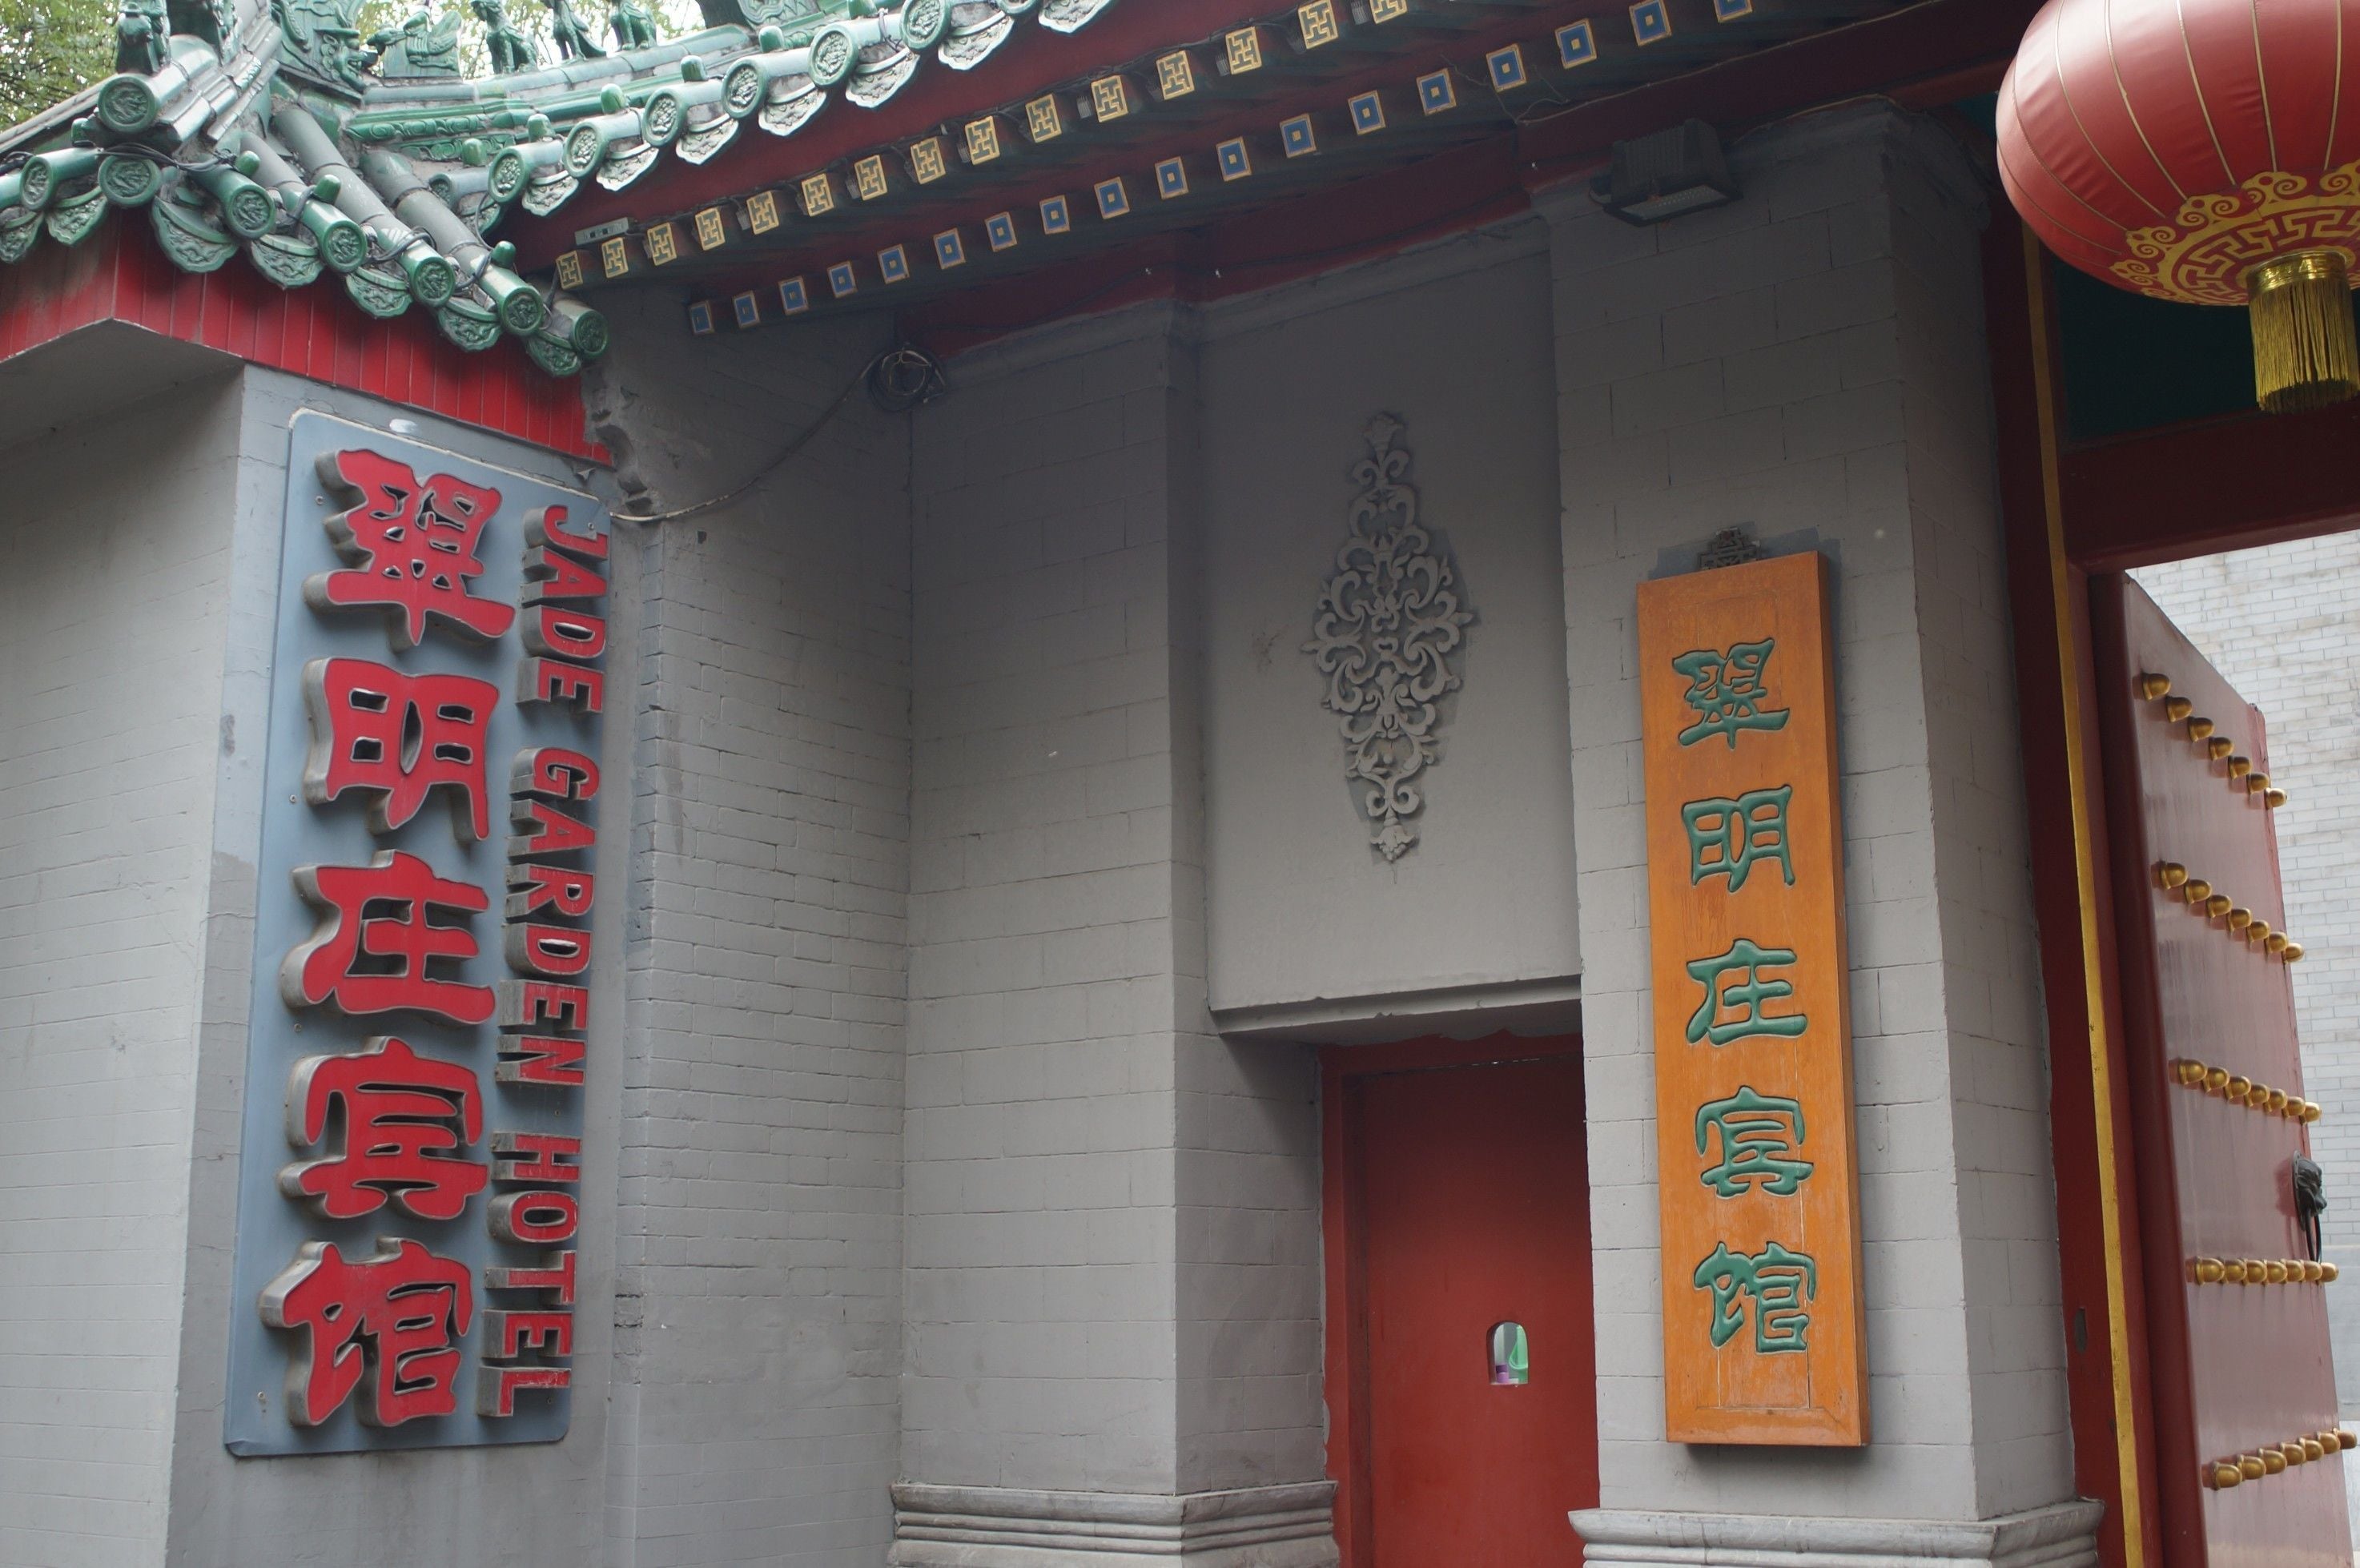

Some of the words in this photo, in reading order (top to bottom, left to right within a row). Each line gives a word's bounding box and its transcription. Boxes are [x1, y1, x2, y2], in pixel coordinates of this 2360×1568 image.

[537, 505, 609, 714] JADE
[281, 448, 517, 1427] 翠明庄宾馆
[519, 747, 601, 1087] GARDEN
[1671, 637, 1818, 1356] 翠明庄宾馆
[498, 1132, 582, 1417] HOTEL
